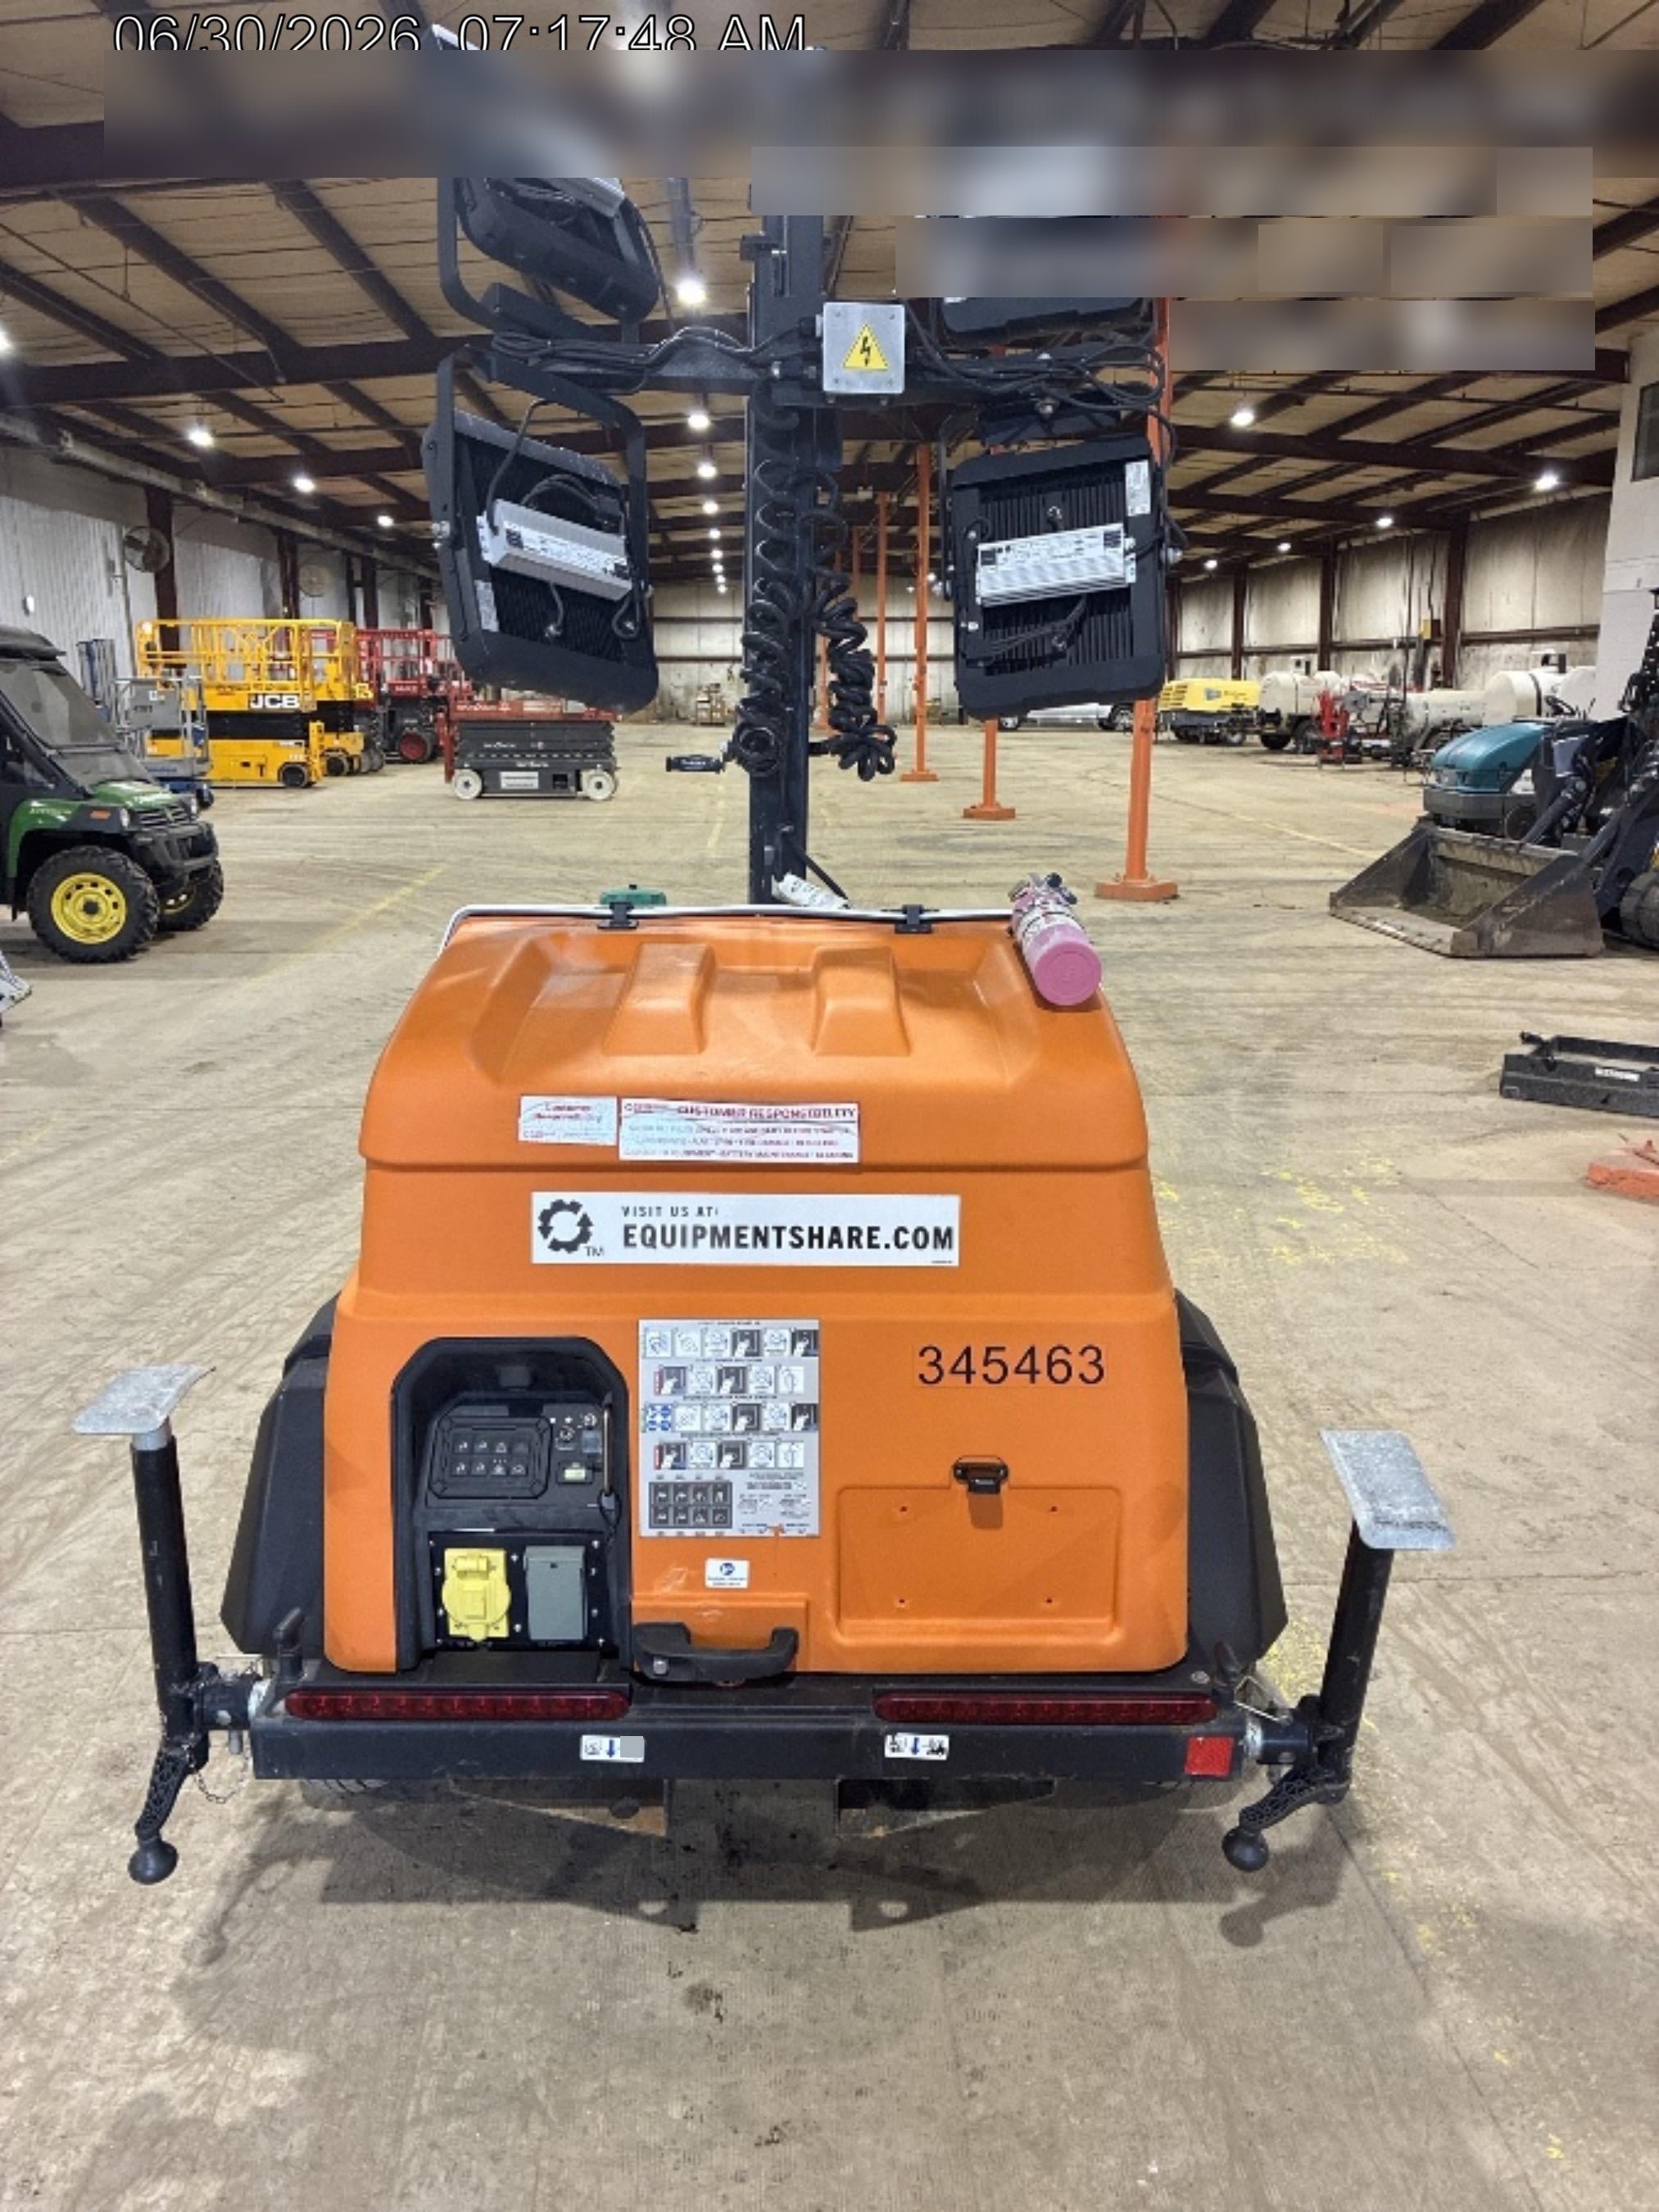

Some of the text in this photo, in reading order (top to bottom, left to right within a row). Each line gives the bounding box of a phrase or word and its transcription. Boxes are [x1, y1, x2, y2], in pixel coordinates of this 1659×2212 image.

[250, 695, 300, 709] JCB
[622, 1205, 662, 1217] VISIT
[670, 1205, 689, 1217] US
[623, 1223, 953, 1251] EQUIPMENTSHARE.COM
[918, 1344, 1105, 1385] 345463
